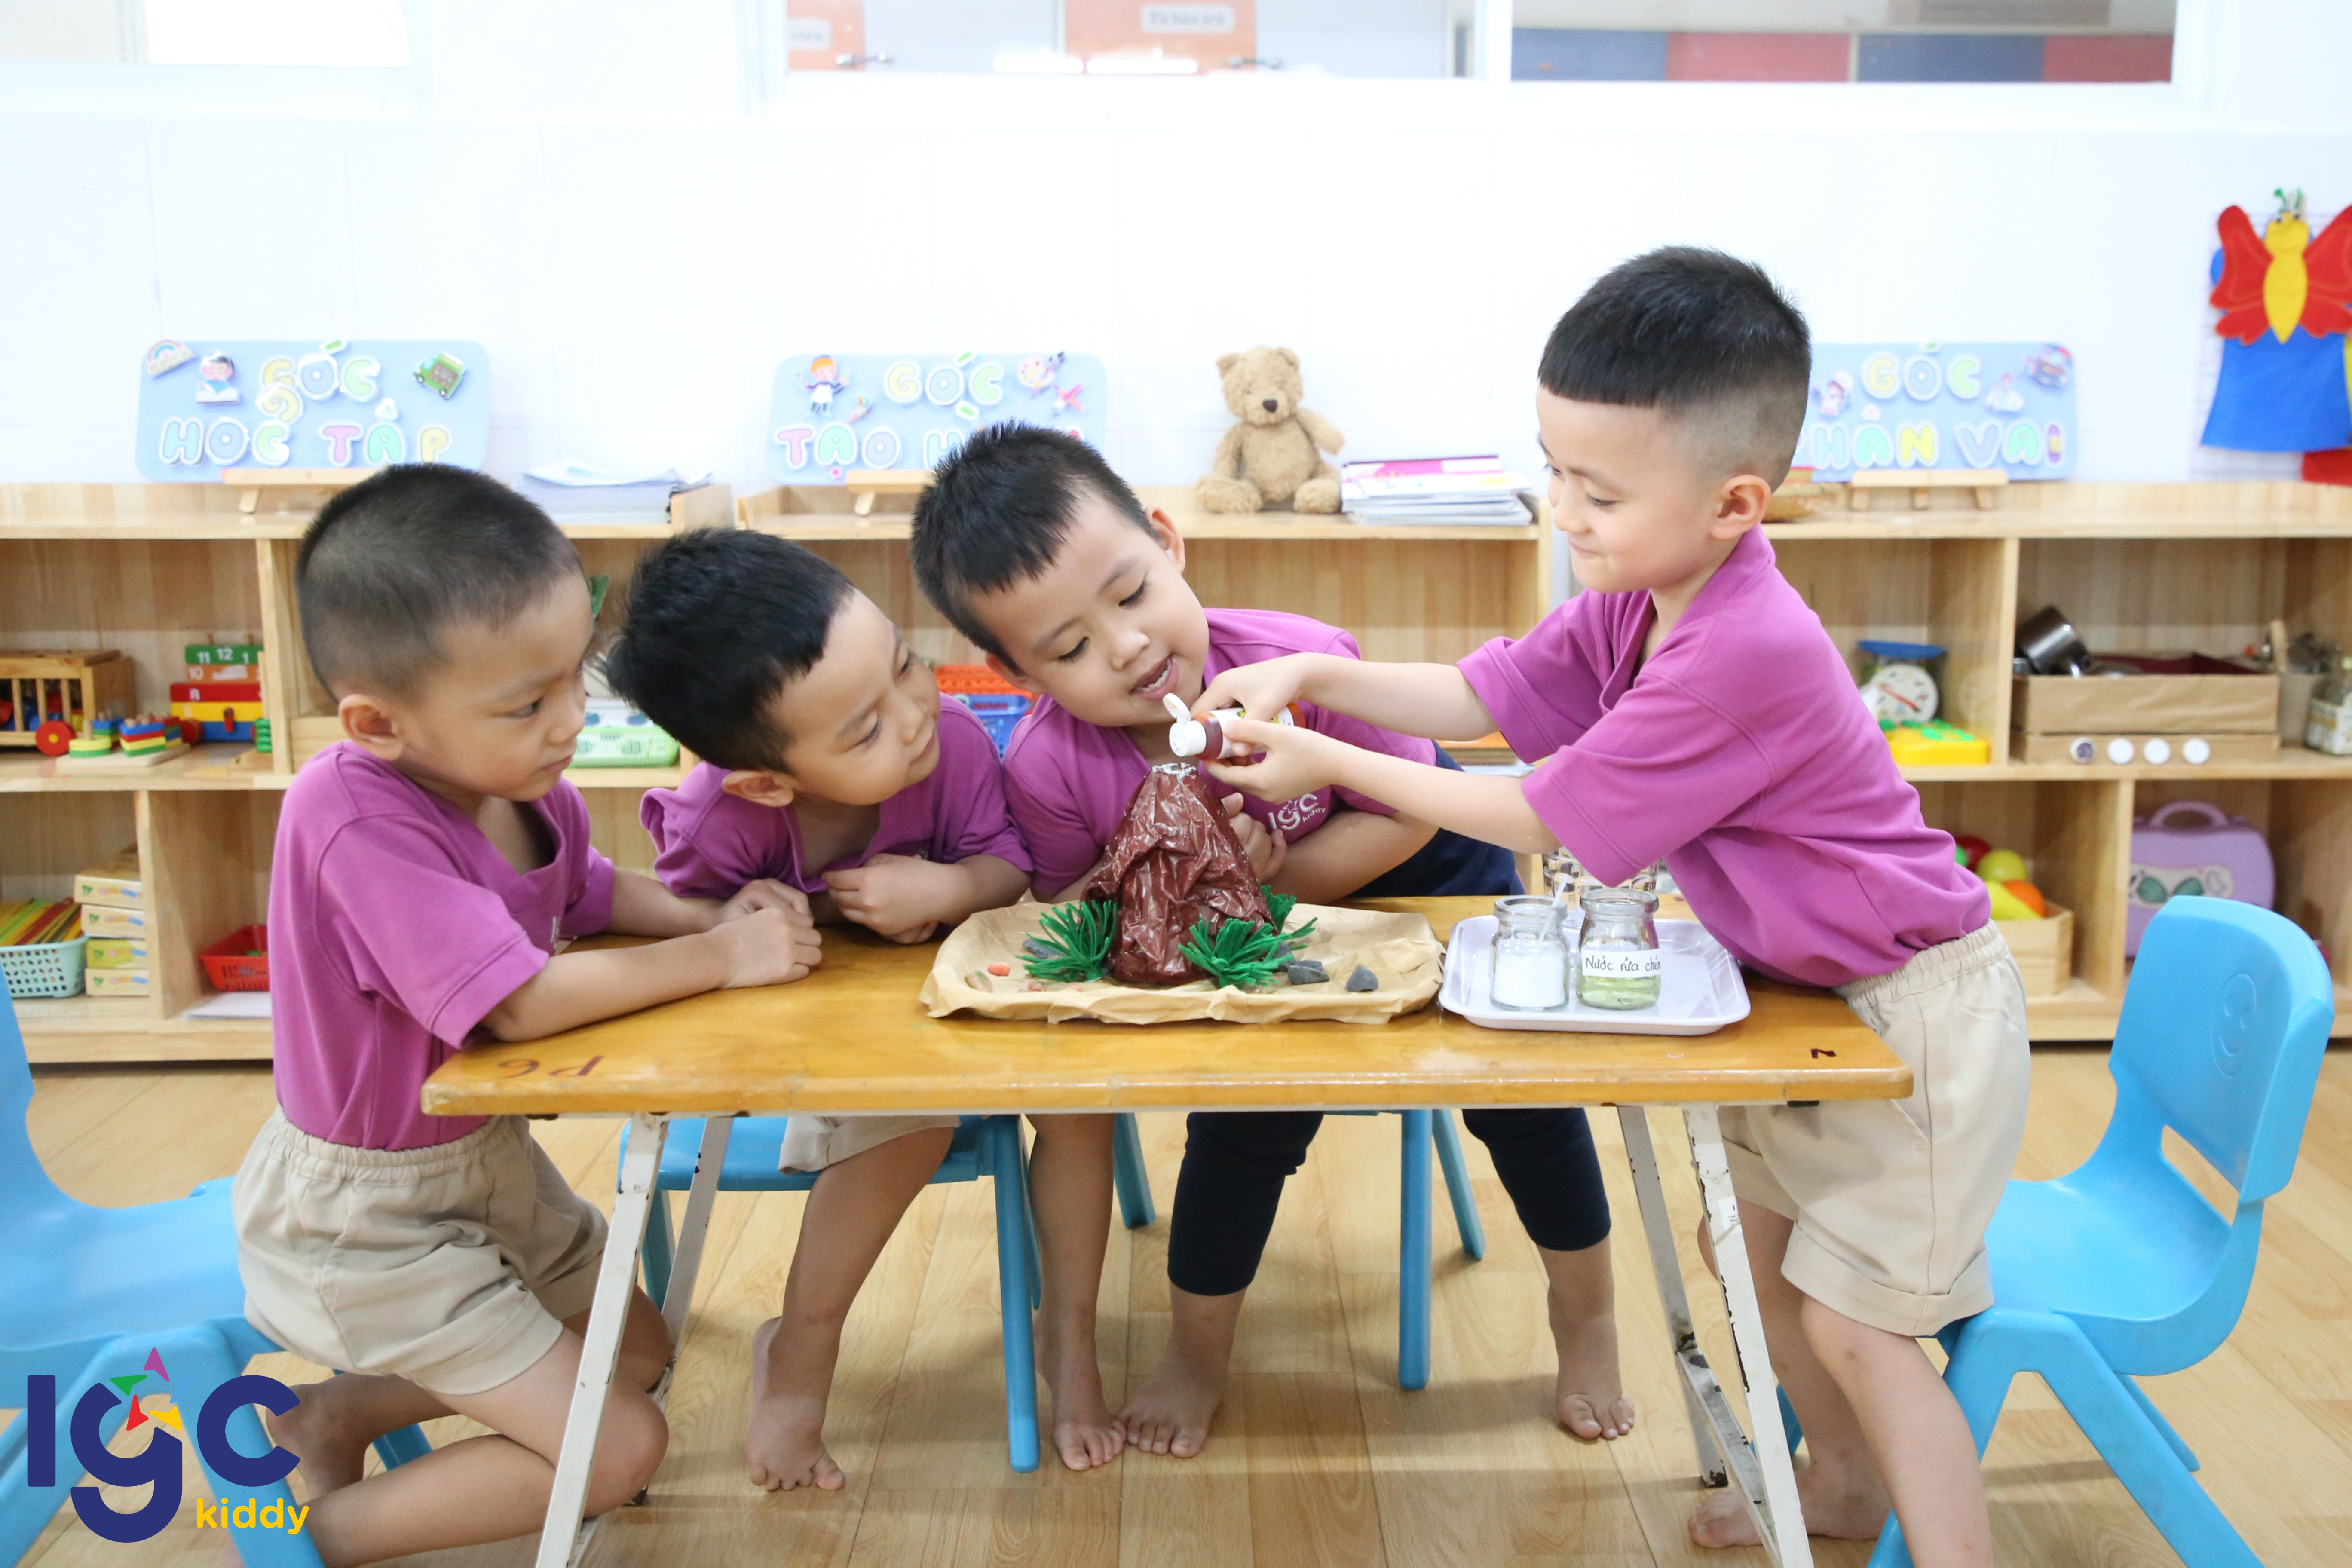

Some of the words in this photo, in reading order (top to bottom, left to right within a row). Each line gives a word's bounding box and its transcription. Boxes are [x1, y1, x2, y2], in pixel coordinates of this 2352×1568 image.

[885, 352, 1004, 405] GÓC
[1956, 419, 2064, 468] VAI
[217, 647, 233, 661] 12
[1586, 955, 1614, 971] Nước
[1620, 956, 1639, 971] rửa
